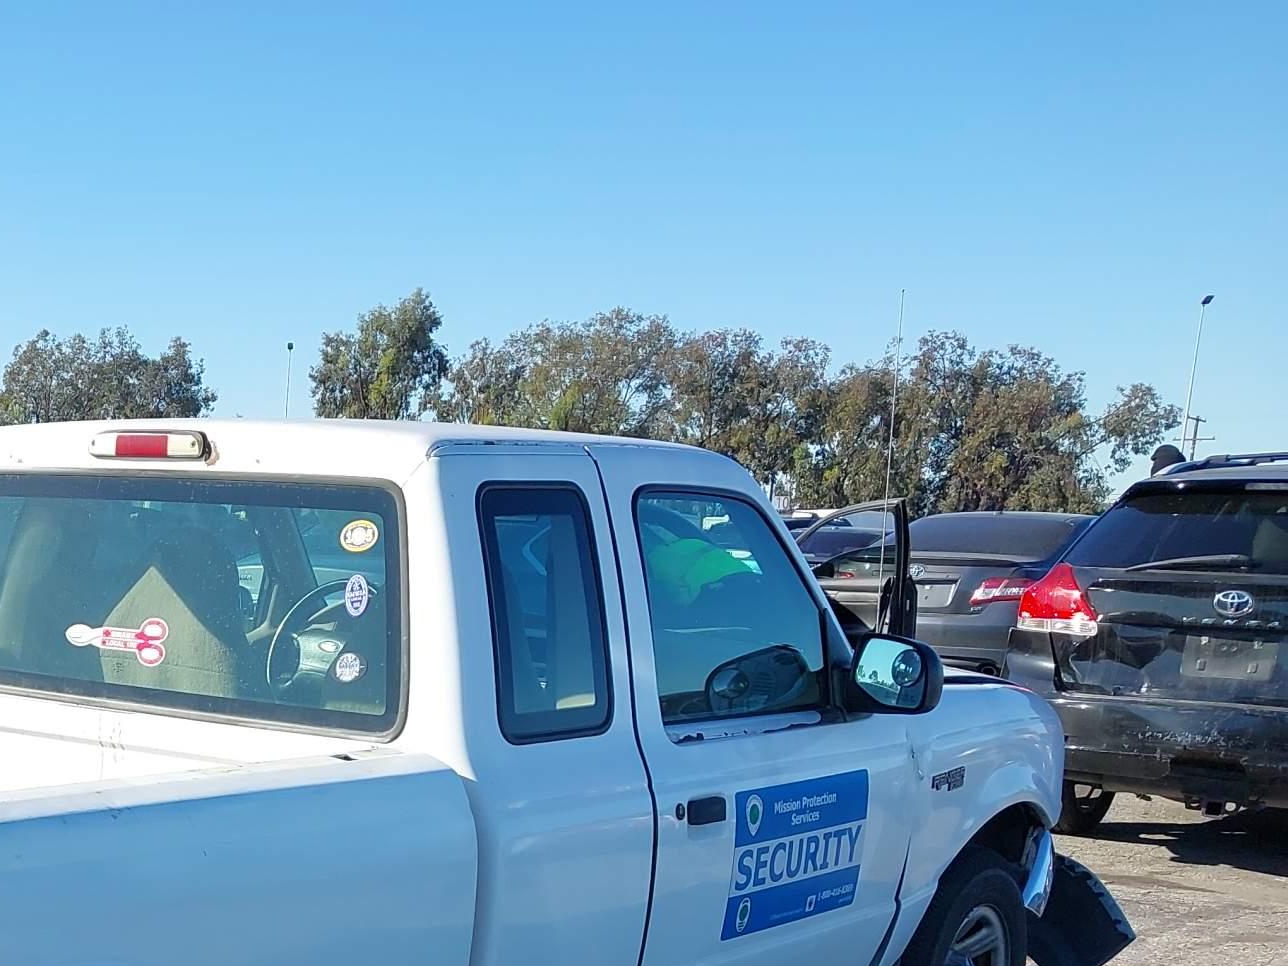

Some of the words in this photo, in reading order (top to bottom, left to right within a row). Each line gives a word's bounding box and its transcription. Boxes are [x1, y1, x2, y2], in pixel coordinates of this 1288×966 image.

[774, 798, 802, 815] Mission
[802, 791, 837, 809] Protection
[790, 809, 821, 826] Services
[734, 824, 863, 892] SECURITY
